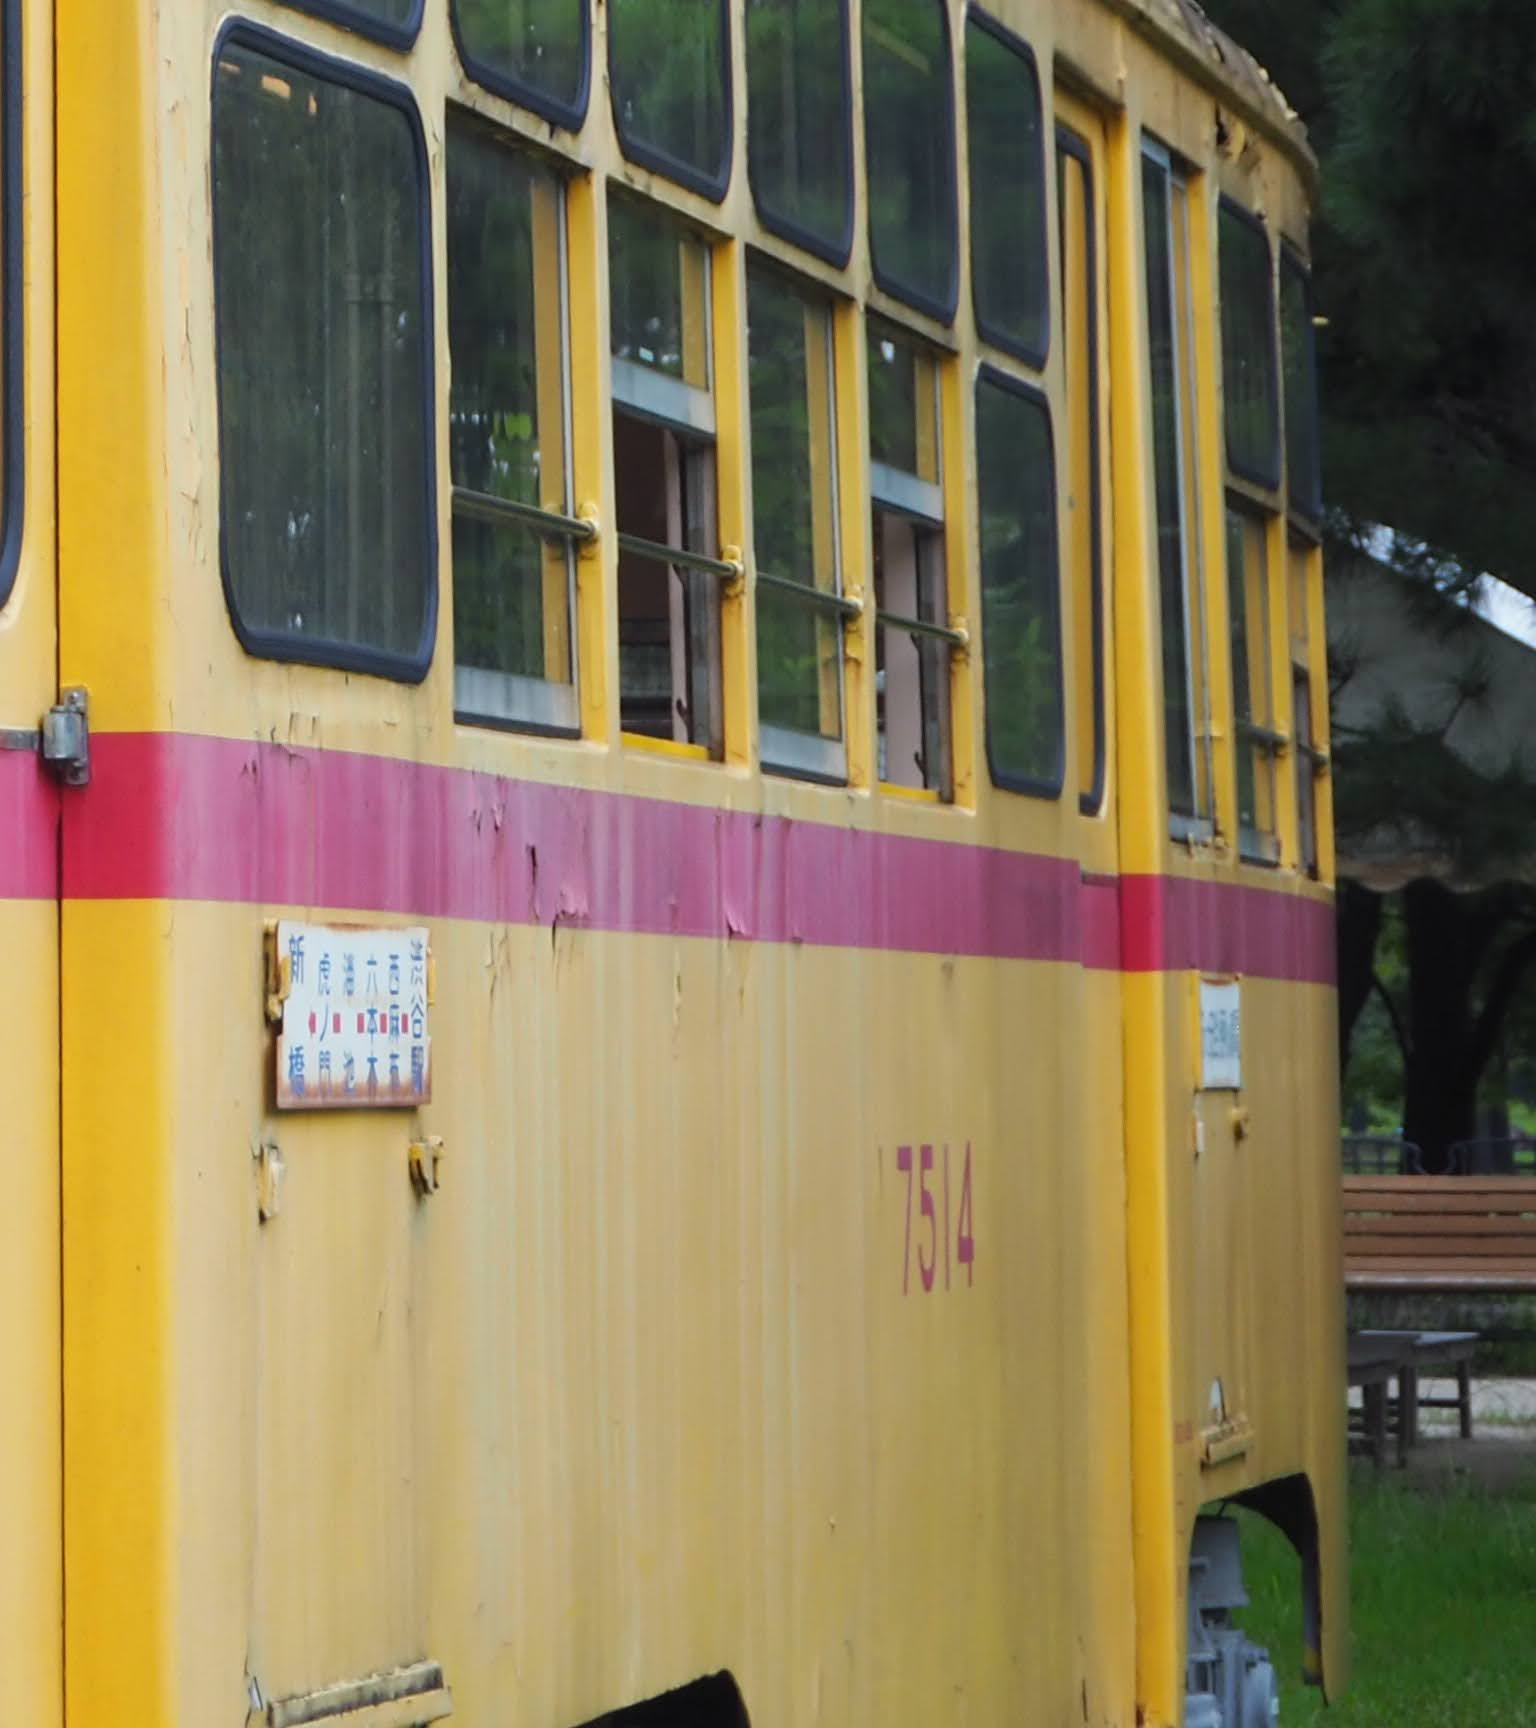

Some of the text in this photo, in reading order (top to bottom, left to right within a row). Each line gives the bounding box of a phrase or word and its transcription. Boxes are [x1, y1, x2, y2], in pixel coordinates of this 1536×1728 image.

[366, 957, 379, 1097] 六本木
[896, 1140, 975, 1296] 7514
